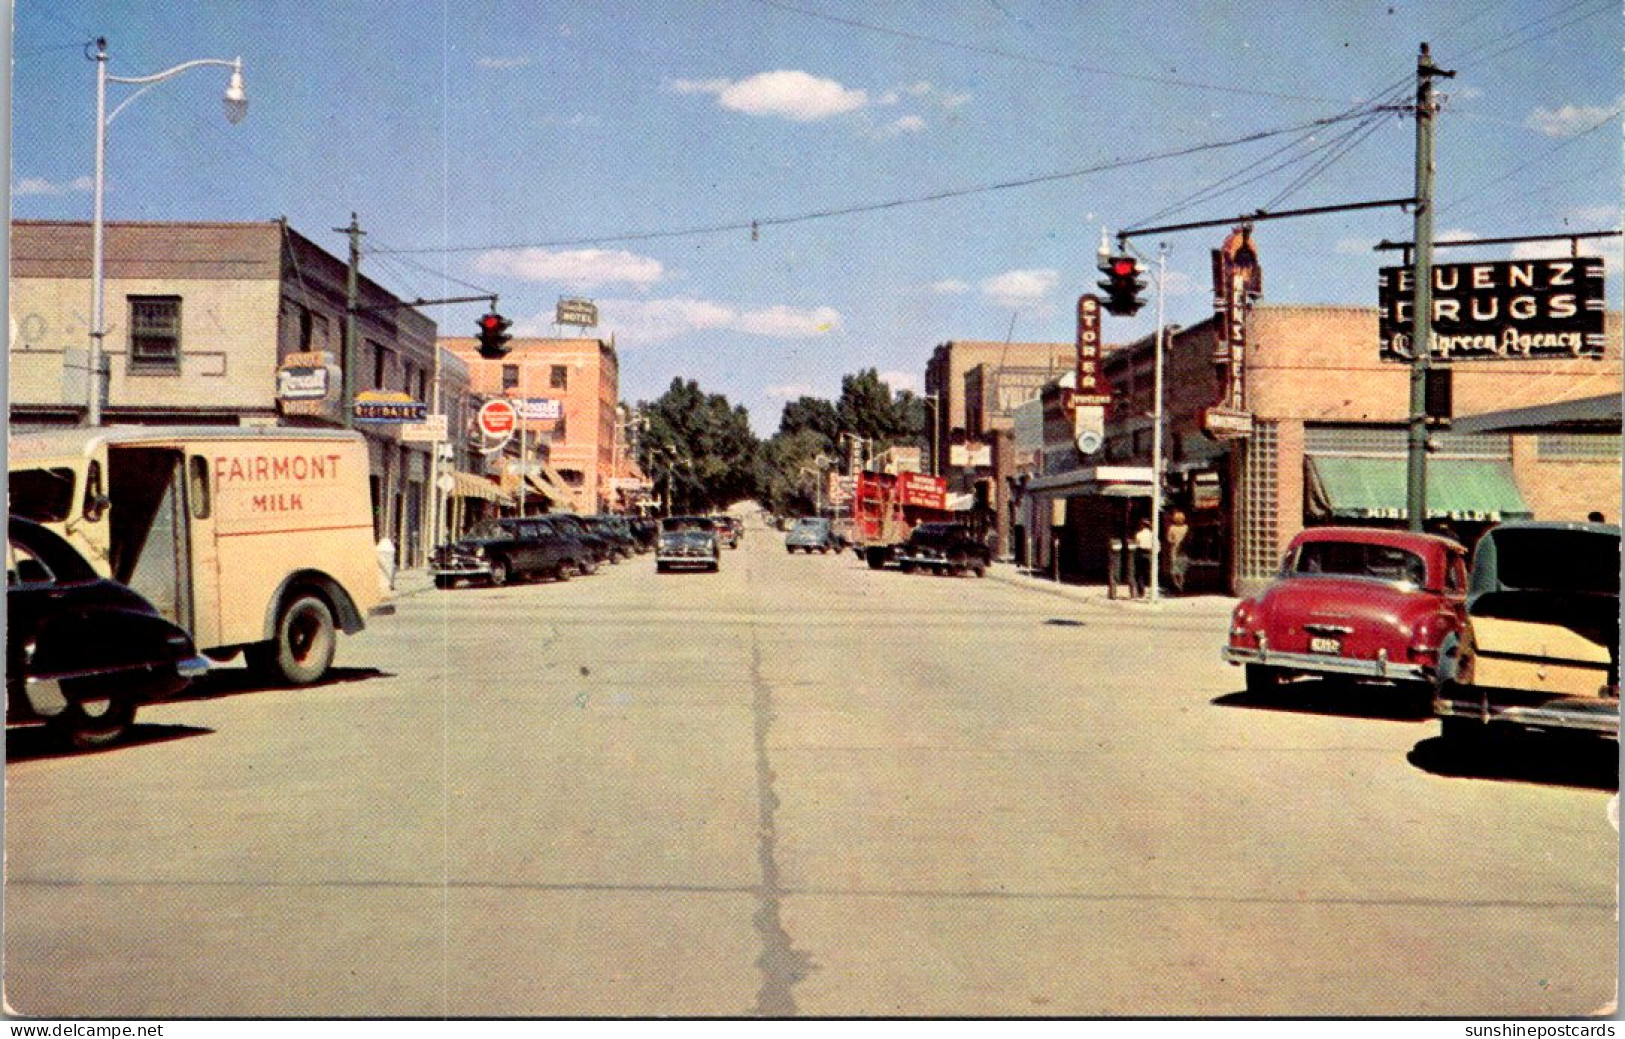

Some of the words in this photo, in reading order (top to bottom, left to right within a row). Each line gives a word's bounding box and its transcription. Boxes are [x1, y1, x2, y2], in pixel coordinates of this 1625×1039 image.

[1500, 327, 1583, 358] Agency
[214, 454, 341, 493] FAIRMONT
[252, 493, 304, 512] MILK
